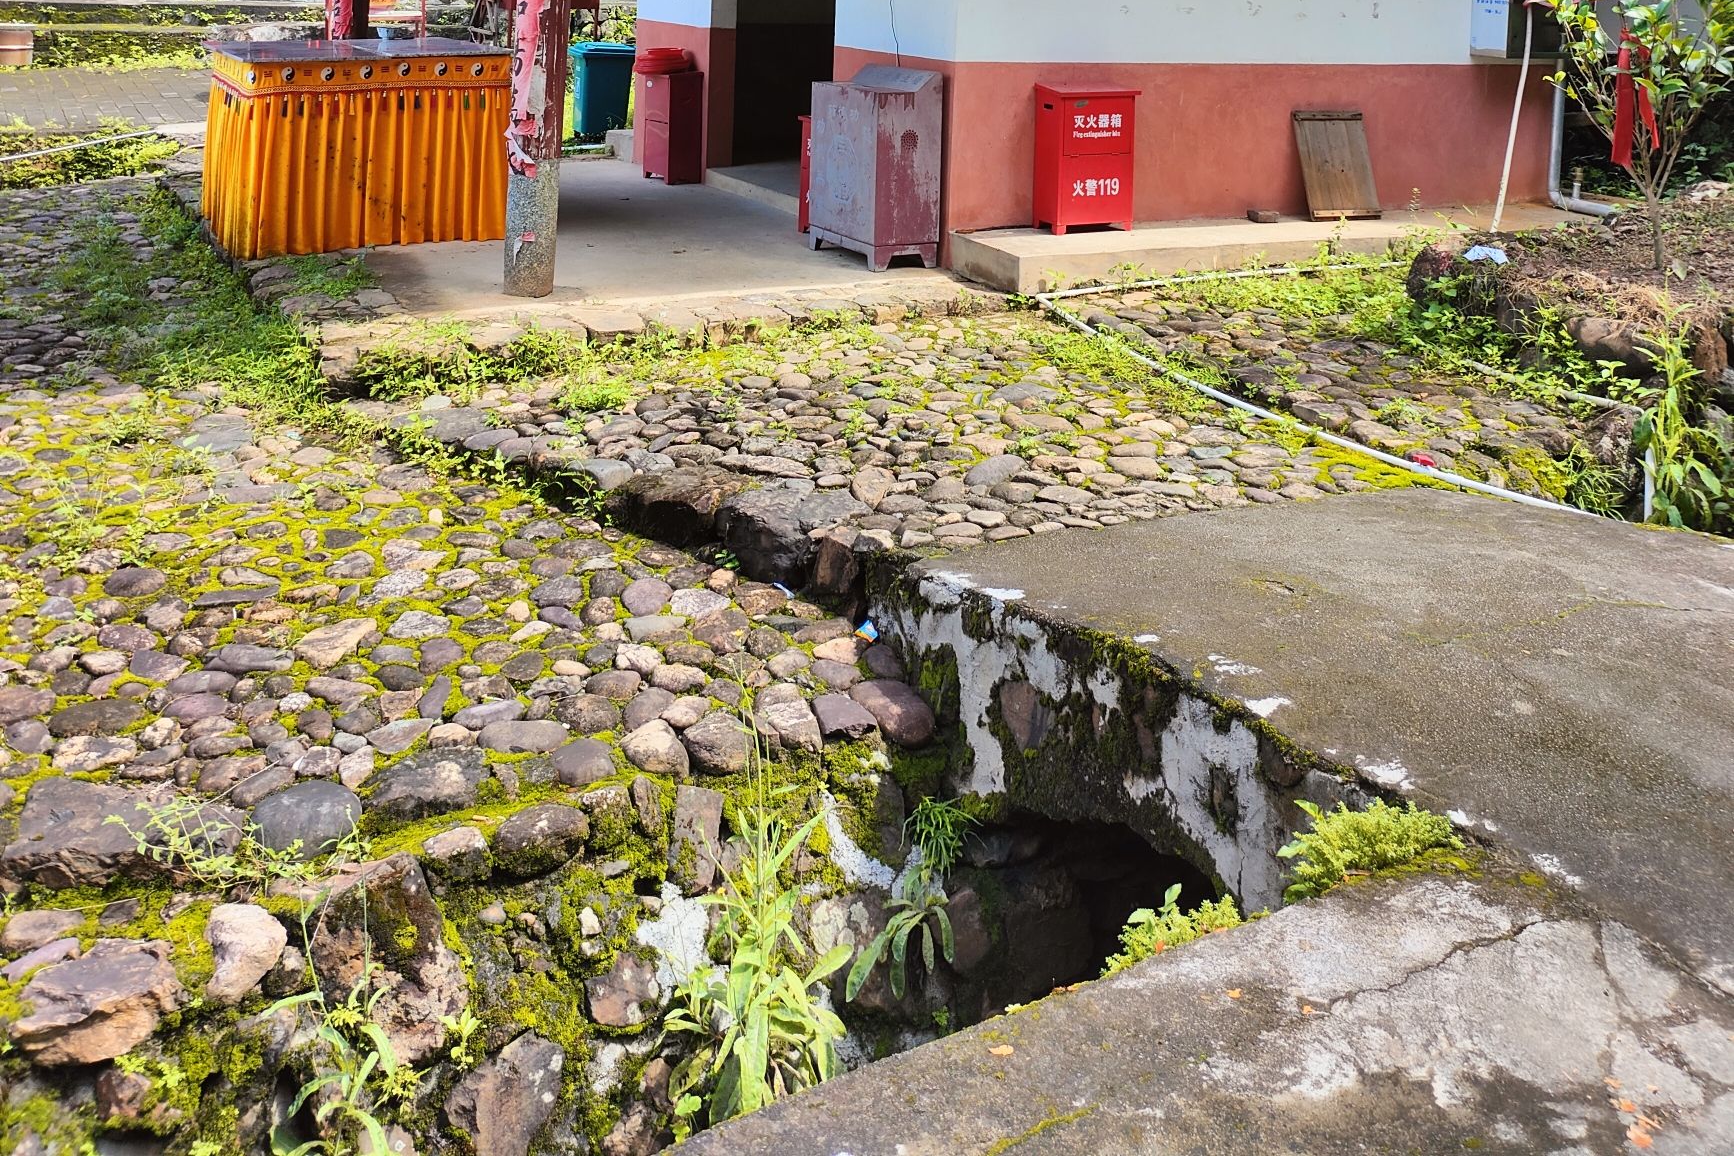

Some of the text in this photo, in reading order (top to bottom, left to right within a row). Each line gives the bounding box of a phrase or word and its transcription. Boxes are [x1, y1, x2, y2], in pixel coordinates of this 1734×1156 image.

[1073, 113, 1122, 128] 灭火器箱
[1072, 177, 1120, 196] 火警119
